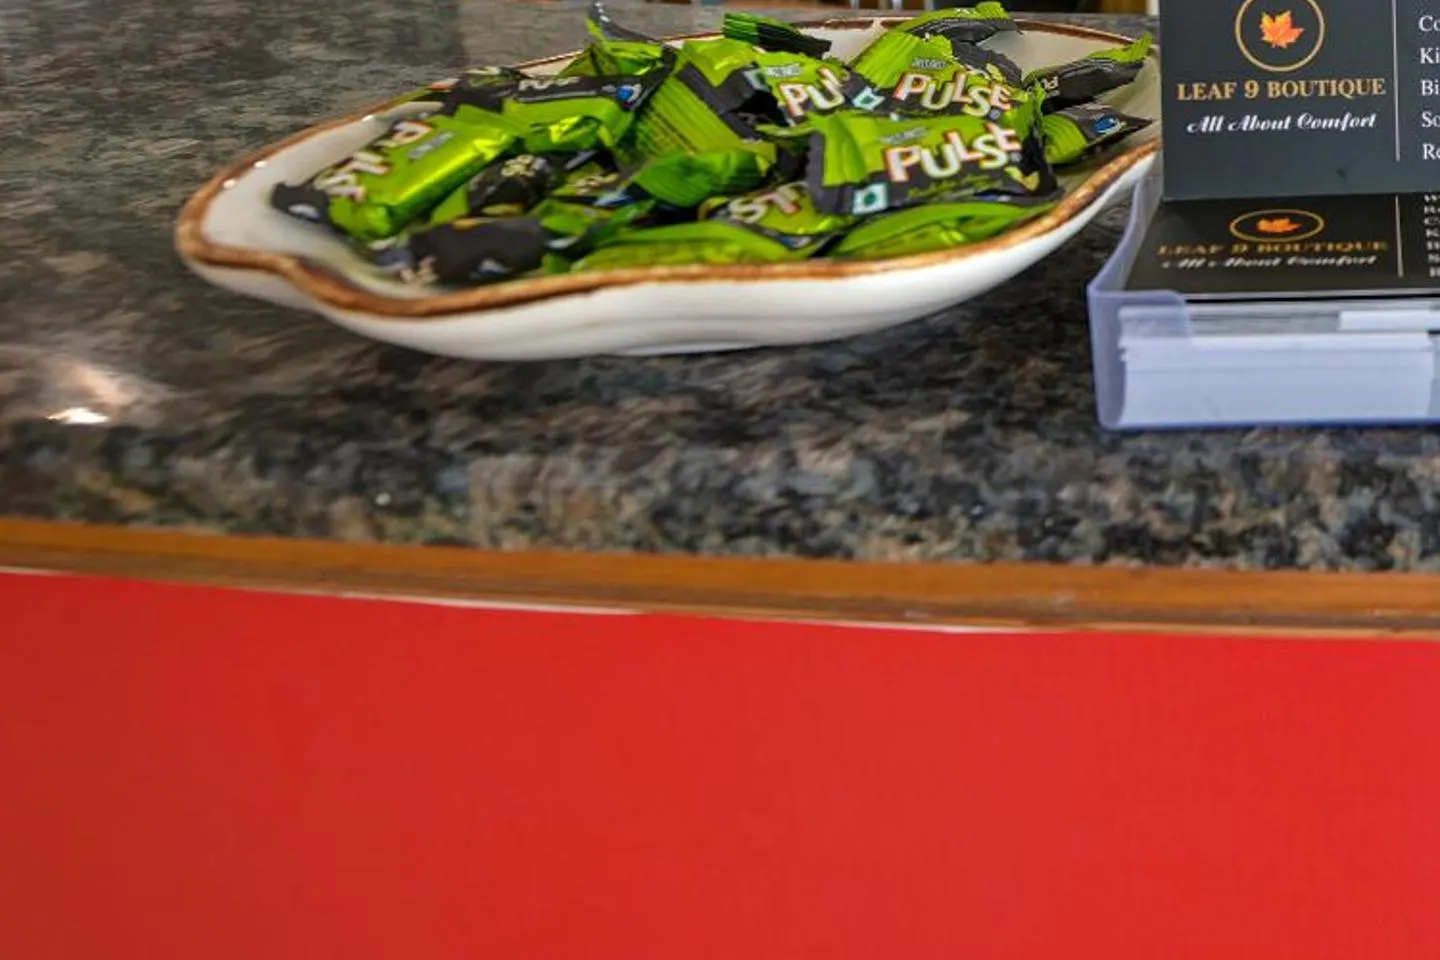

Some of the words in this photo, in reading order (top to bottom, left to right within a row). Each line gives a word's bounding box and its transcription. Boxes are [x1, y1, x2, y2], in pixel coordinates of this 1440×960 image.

[892, 71, 1013, 117] PULSE
[1176, 81, 1238, 101] LEAF
[1244, 80, 1259, 99] 9
[1267, 78, 1387, 100] BOUTIQUE
[1187, 113, 1223, 134] All
[1228, 112, 1291, 133] About
[1297, 111, 1377, 131] Comfort
[884, 121, 1022, 183] PULSE
